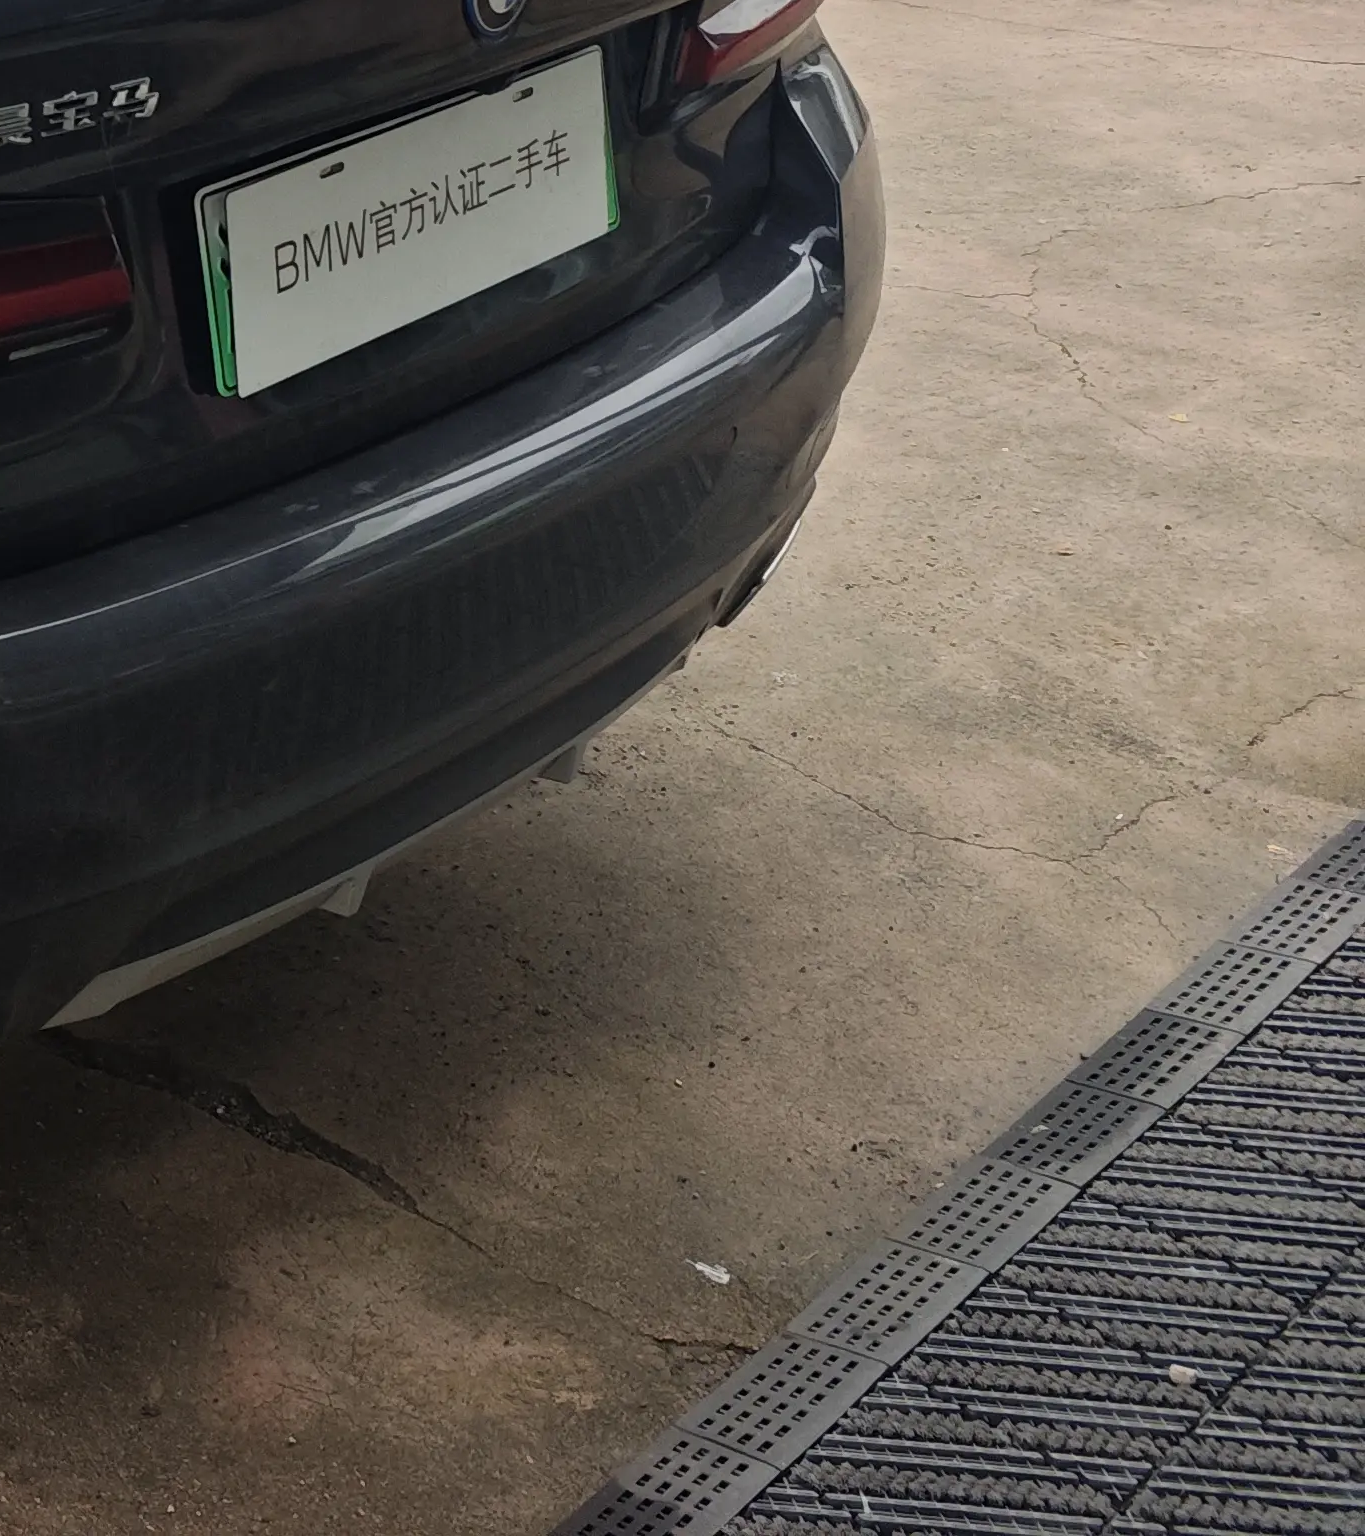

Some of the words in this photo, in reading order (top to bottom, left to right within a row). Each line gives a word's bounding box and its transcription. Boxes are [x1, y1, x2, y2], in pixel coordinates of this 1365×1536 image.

[274, 129, 570, 294] BMW官方认证二手车
